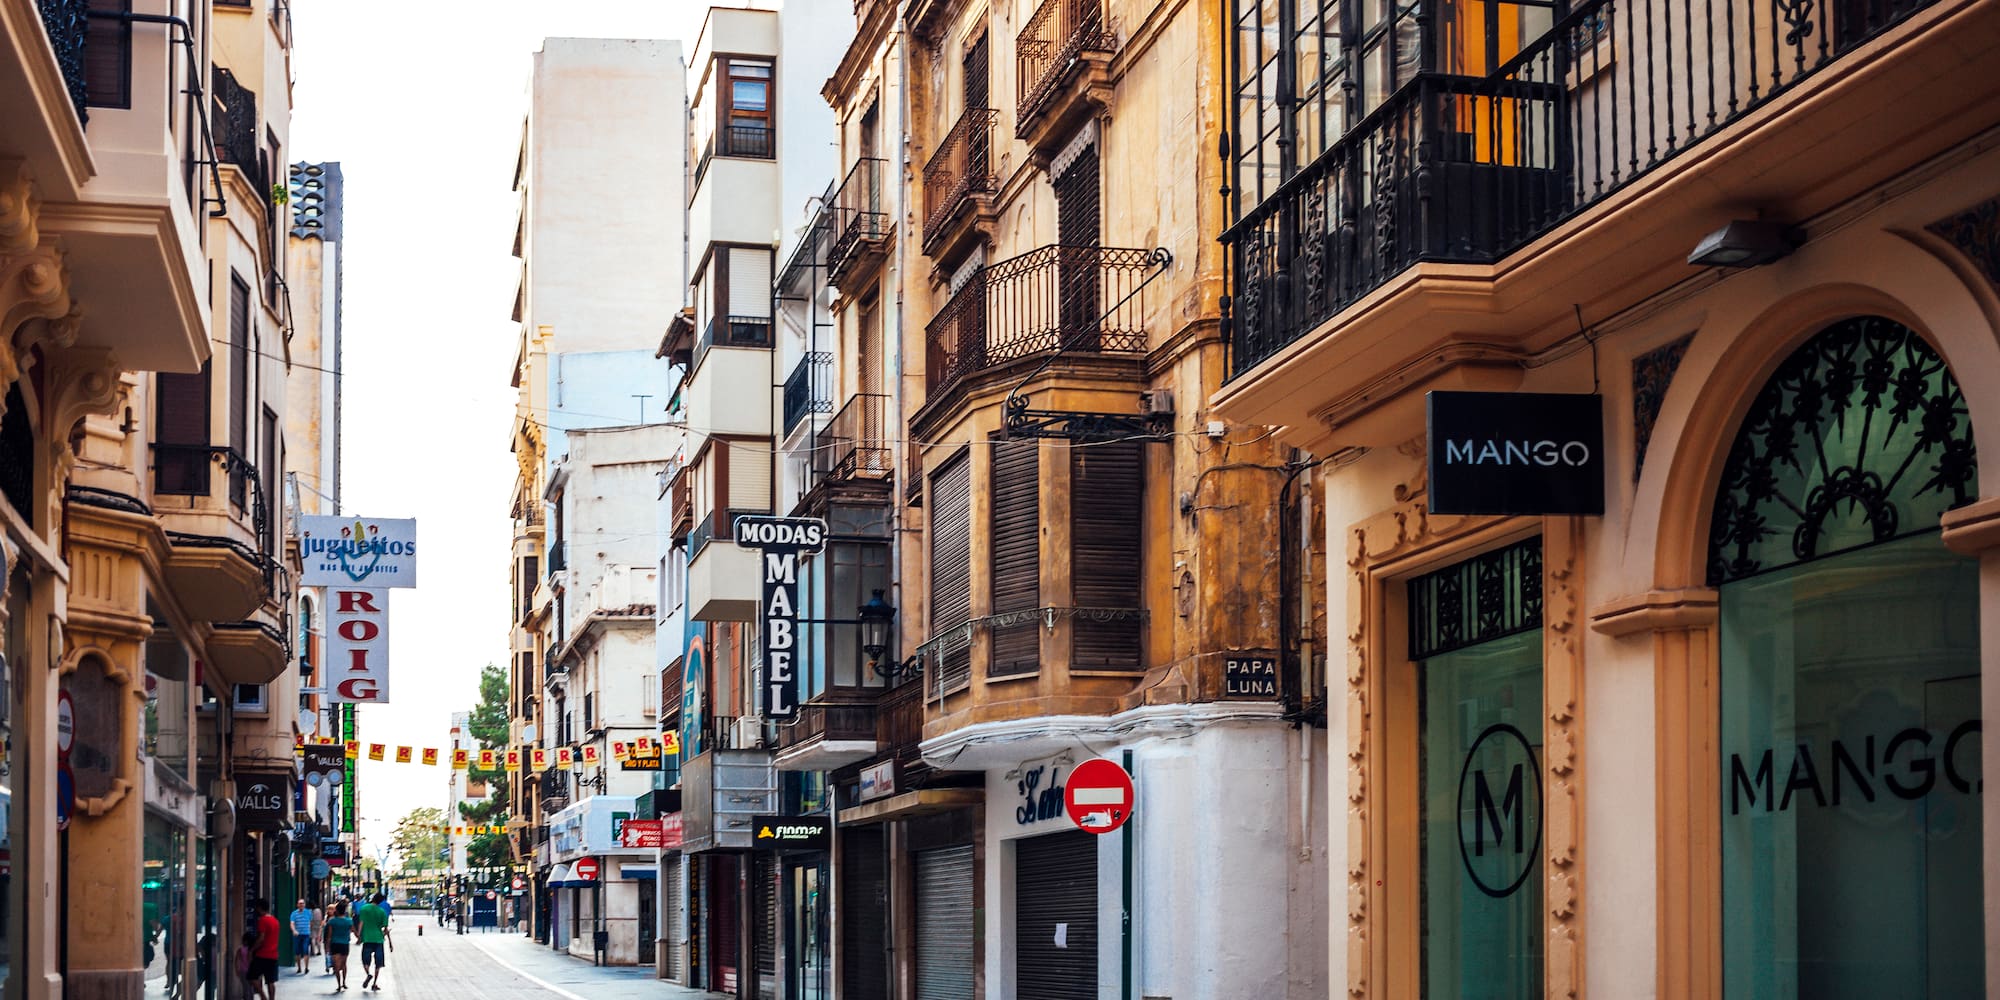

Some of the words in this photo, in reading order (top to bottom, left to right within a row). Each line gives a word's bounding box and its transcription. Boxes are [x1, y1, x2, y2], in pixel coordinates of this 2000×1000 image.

[1446, 438, 1589, 466] MANGO
[740, 523, 821, 546] MODAS
[766, 552, 796, 715] MABEL
[336, 591, 381, 699] ROIG
[1227, 660, 1275, 674] PAPA
[1227, 680, 1275, 695] LUNA
[638, 738, 649, 749] R
[664, 733, 674, 747] R
[586, 747, 596, 759] R
[614, 742, 625, 755] R
[318, 756, 343, 767] VALLS
[456, 751, 466, 762] R
[483, 752, 492, 763] R
[508, 752, 518, 764] R
[535, 751, 544, 763] R
[560, 749, 570, 762] R
[1731, 719, 1983, 815] MANGO
[237, 795, 281, 810] VALLS
[774, 826, 823, 839] finmar
